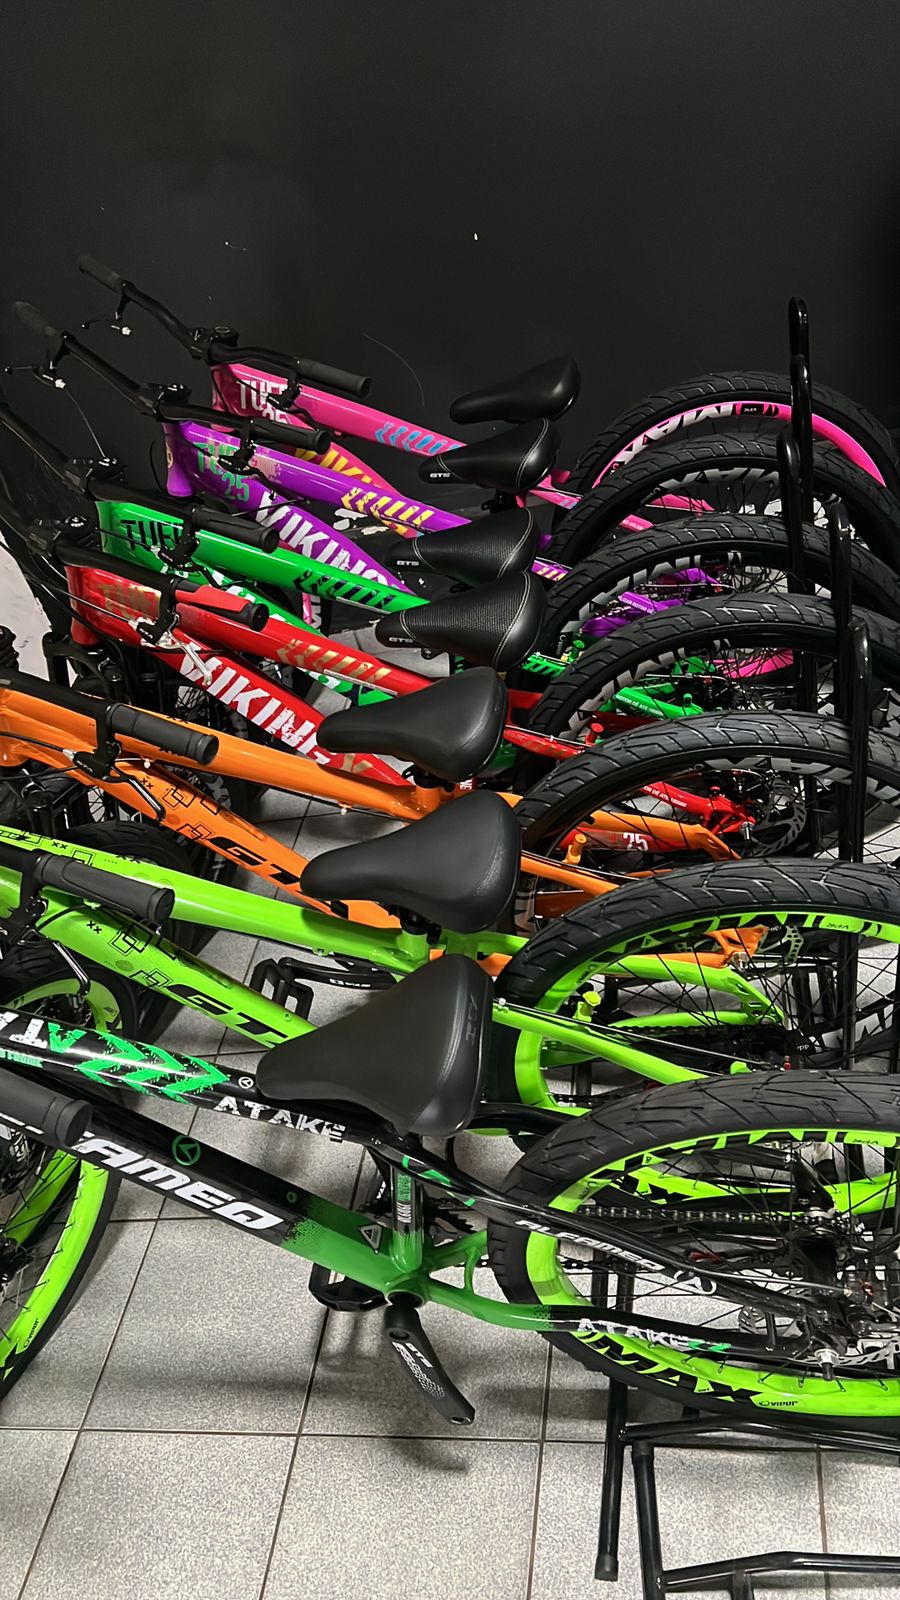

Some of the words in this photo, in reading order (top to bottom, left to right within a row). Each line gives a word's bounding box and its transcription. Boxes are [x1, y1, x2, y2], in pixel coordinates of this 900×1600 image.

[222, 472, 249, 502] 25
[623, 832, 649, 852] 25
[405, 1342, 433, 1368] GTS
